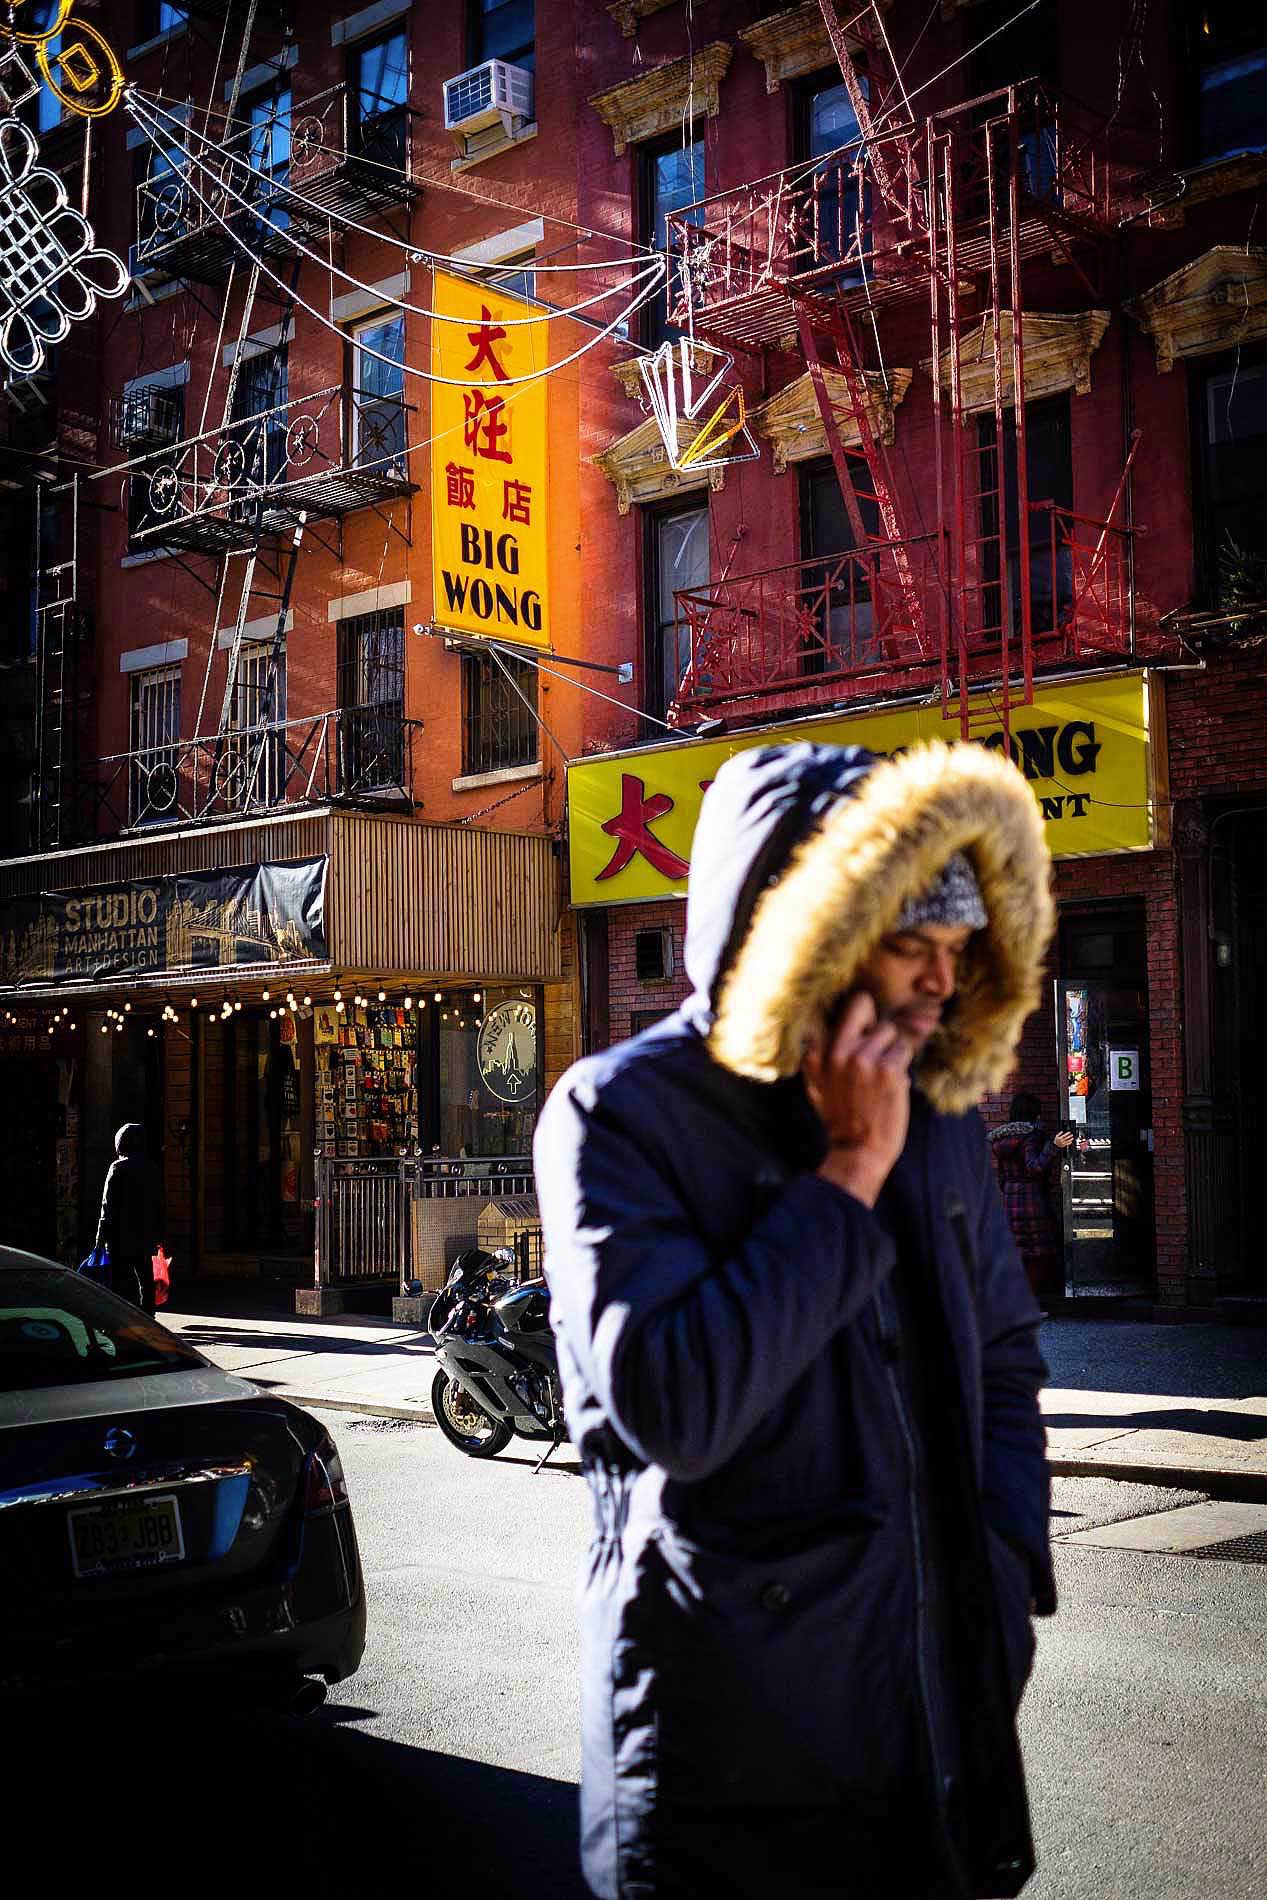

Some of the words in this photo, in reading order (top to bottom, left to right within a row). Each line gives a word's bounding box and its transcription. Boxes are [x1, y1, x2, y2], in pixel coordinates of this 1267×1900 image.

[460, 522, 519, 575] BIG
[442, 570, 542, 630] WONG
[65, 889, 157, 932] STUDIO
[64, 926, 158, 955] MANHATTAN
[1118, 1056, 1132, 1079] B
